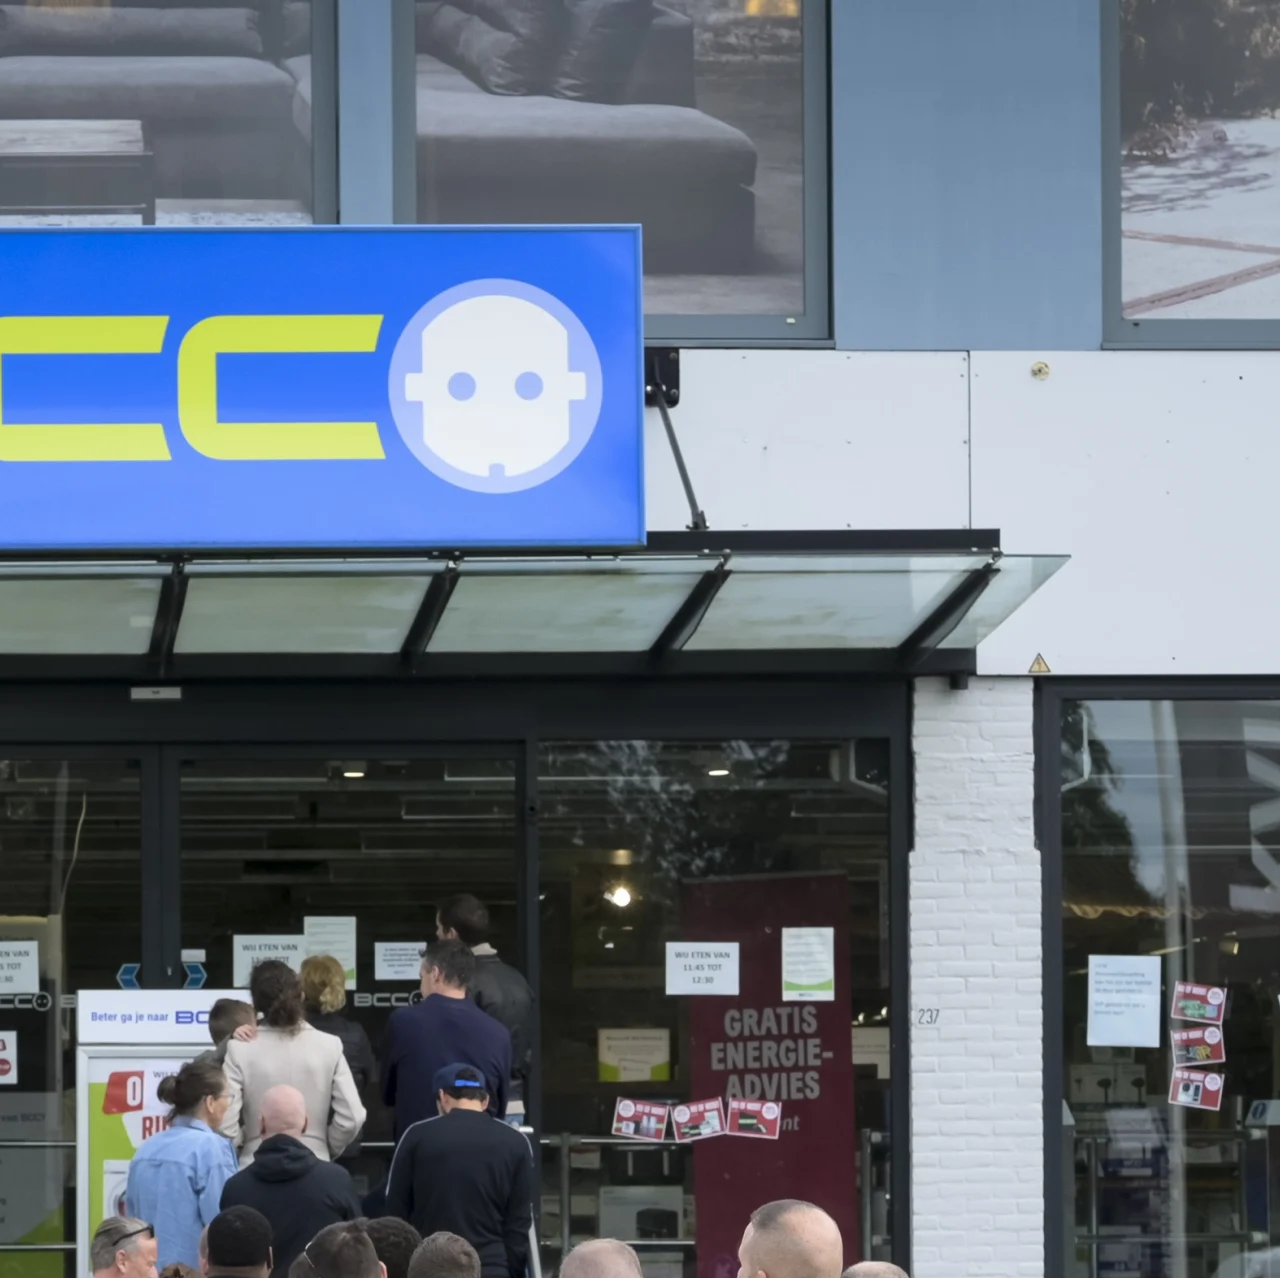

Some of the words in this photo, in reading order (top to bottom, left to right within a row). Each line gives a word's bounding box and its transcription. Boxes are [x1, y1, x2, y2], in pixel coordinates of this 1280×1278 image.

[12, 950, 30, 958] VAN
[691, 951, 711, 959] ETEN
[713, 951, 730, 959] VAN
[6, 962, 22, 970] TOT
[354, 993, 410, 1007] BCC
[91, 1012, 117, 1022] Beter
[121, 1014, 132, 1025] ga
[136, 1012, 144, 1025] je
[147, 1013, 168, 1022] naar
[175, 1010, 209, 1024] BC
[724, 1005, 818, 1038] GRATIS
[918, 1008, 940, 1024] 237
[710, 1038, 834, 1071] ENERGIE-
[726, 1071, 820, 1101] ADVIES
